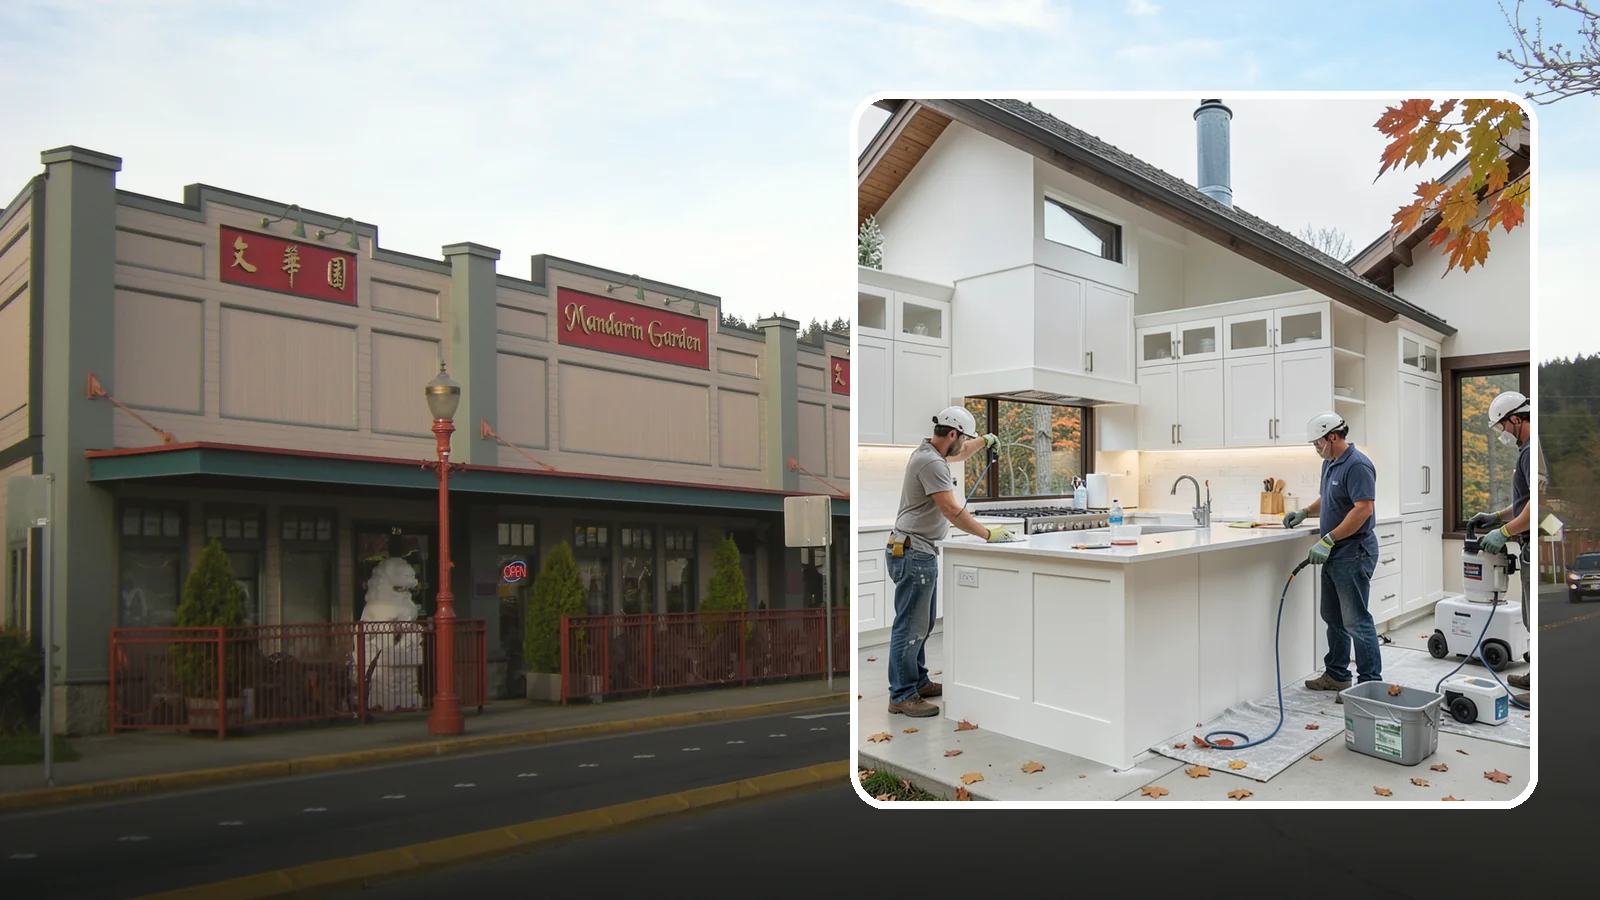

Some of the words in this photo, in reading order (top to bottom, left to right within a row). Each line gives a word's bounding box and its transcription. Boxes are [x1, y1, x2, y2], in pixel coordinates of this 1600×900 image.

[231, 236, 346, 291] 文華園
[565, 302, 644, 341] Mandarin
[648, 320, 702, 352] Garden
[503, 565, 527, 579] OPEN
